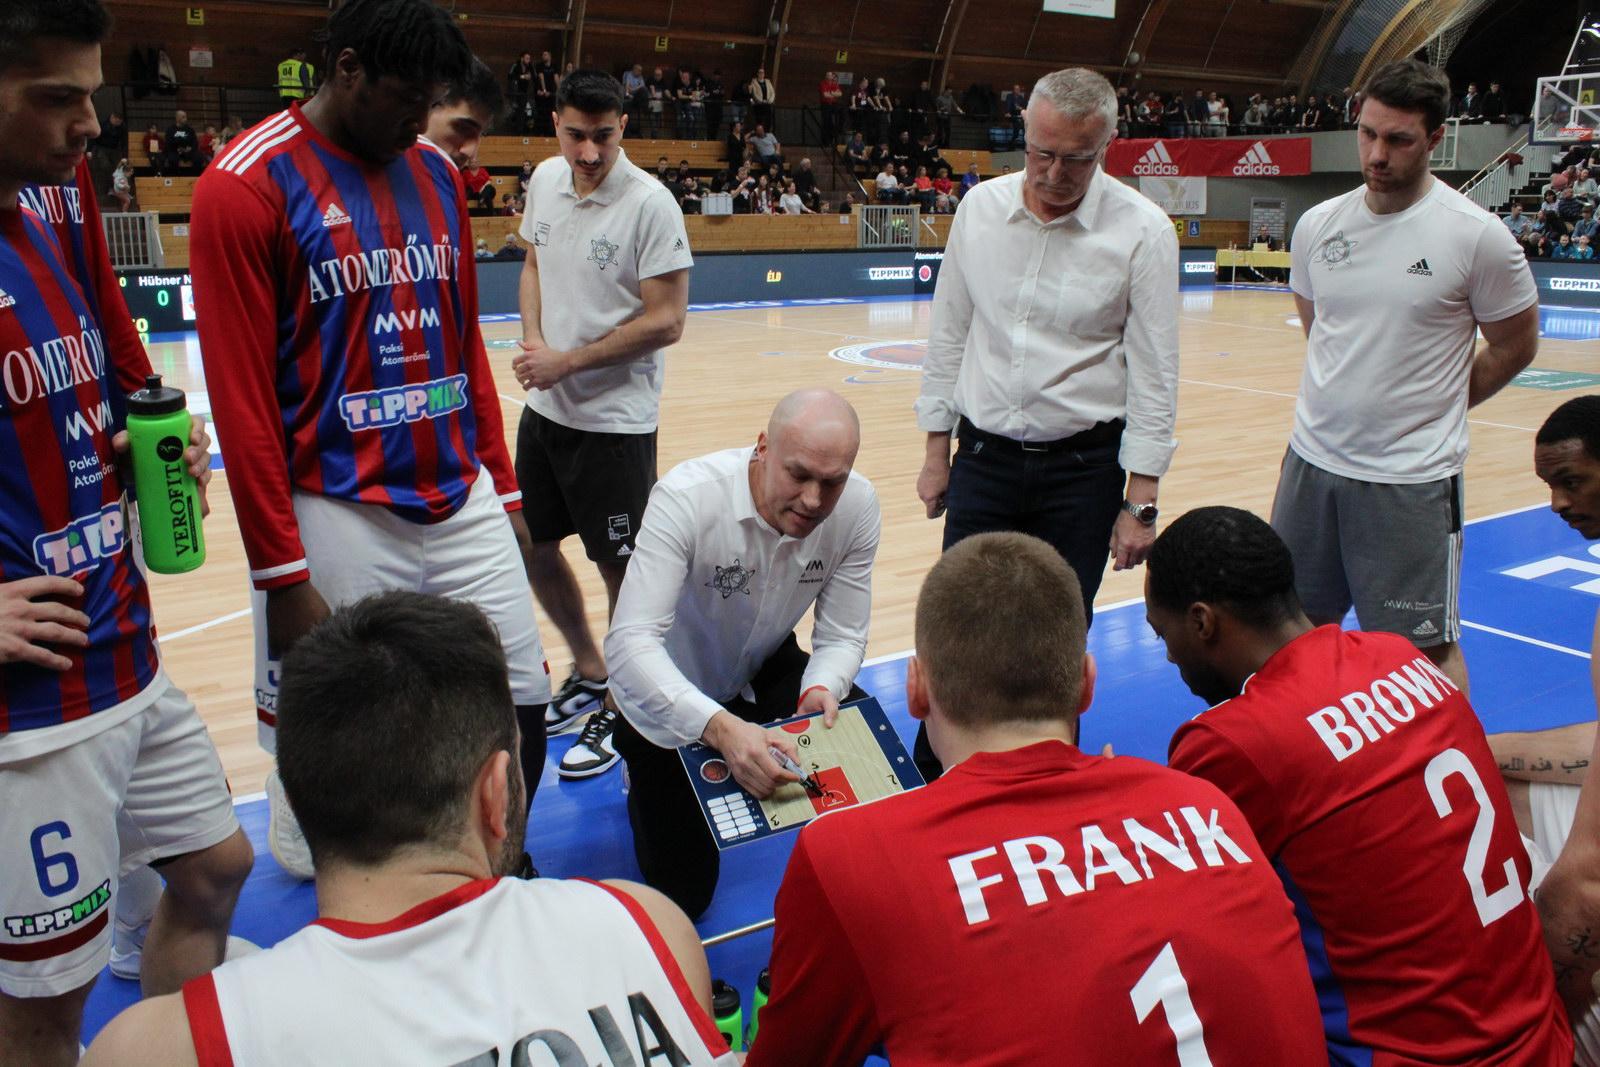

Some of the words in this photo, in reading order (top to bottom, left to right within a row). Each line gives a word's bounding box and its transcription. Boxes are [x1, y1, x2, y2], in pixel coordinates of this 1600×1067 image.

[1133, 163, 1179, 176] adidas
[1233, 163, 1280, 176] adidas
[138, 275, 181, 286] Hübner
[1406, 267, 1433, 277] adidas
[157, 289, 169, 306] 0
[374, 307, 441, 335] MVM
[379, 342, 404, 355] Paksi
[68, 451, 100, 473] Paksi
[164, 463, 190, 558] VEROFIT
[1306, 656, 1460, 763] BROWN
[1423, 747, 1525, 928] 2
[30, 820, 80, 898] 6
[948, 806, 1252, 925] FRANK
[1129, 942, 1214, 1067] 1
